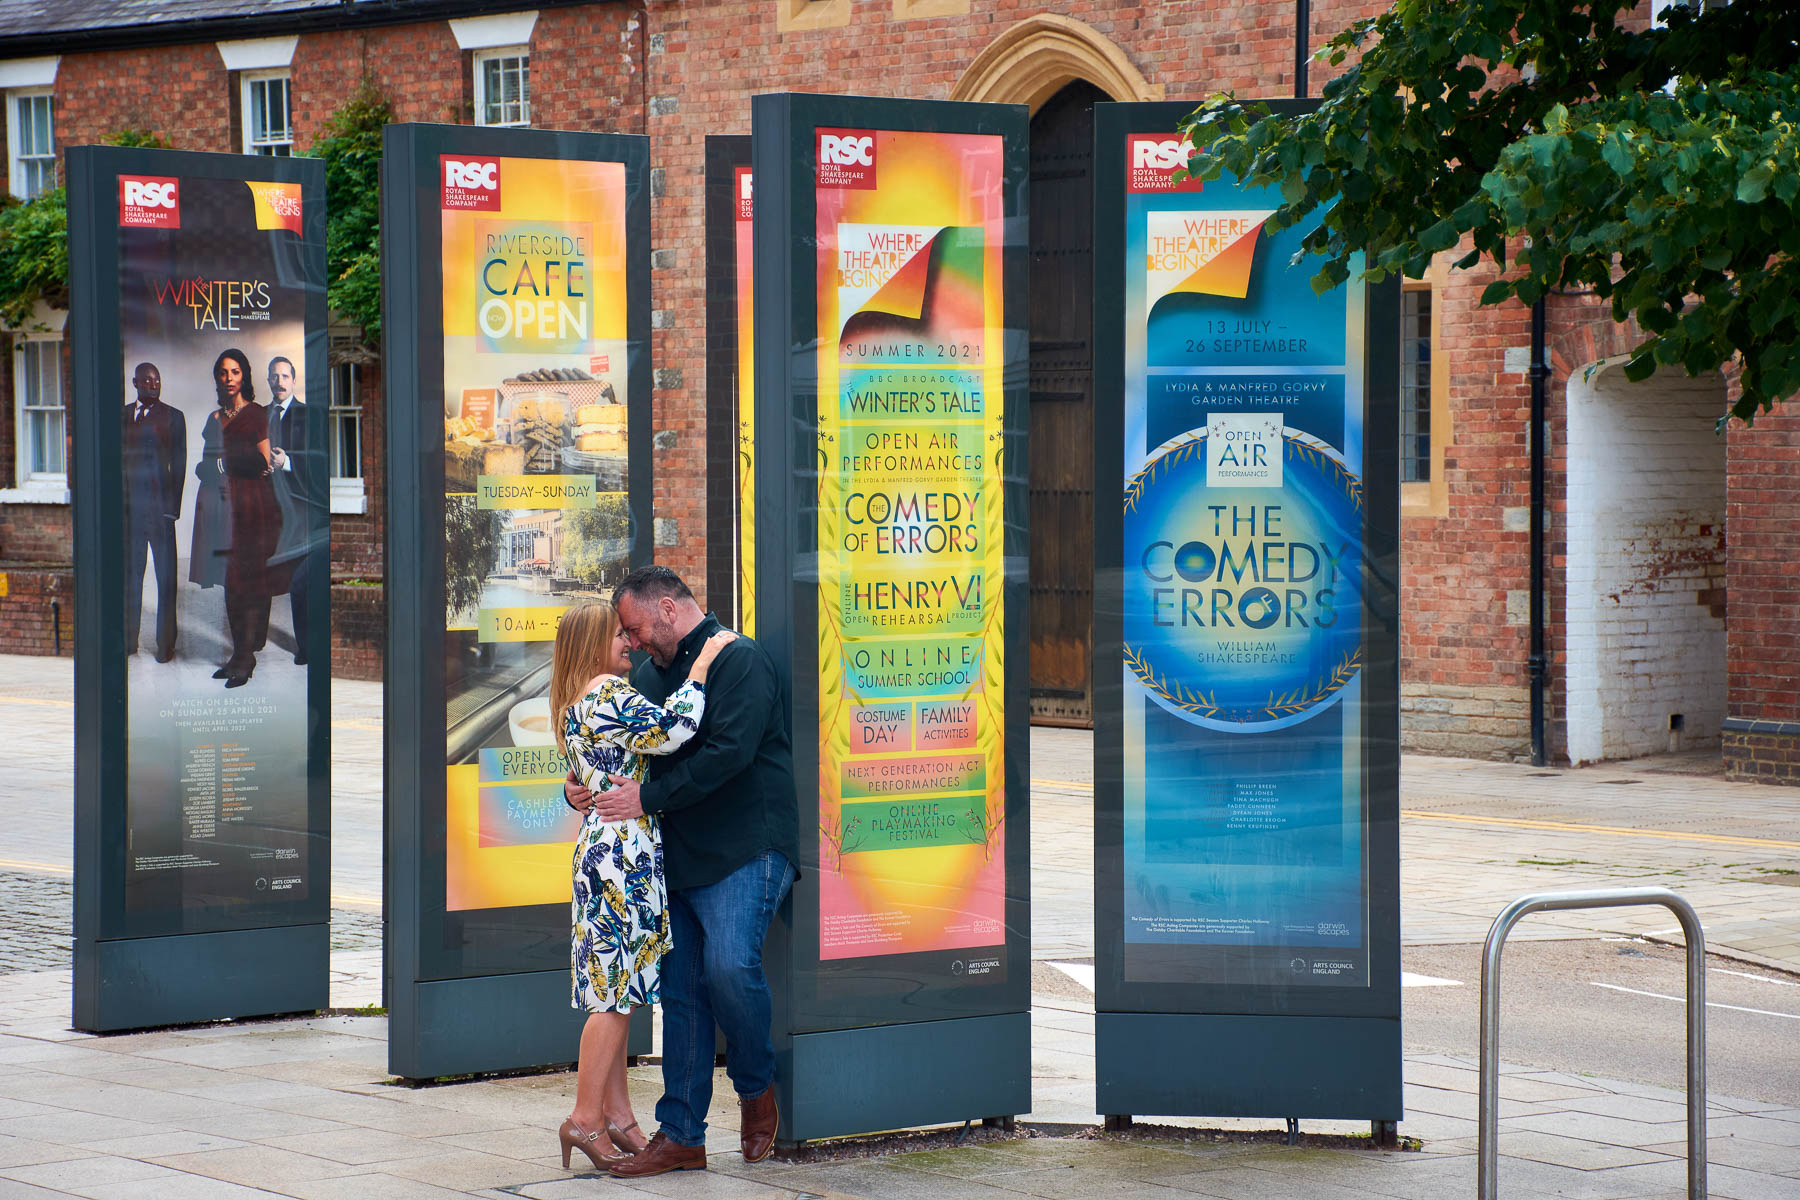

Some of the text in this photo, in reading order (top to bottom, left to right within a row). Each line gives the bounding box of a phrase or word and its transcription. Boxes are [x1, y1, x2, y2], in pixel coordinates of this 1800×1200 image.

[821, 135, 873, 166] RSC
[445, 160, 496, 190] RSC
[821, 170, 864, 179] SHAKESPEARE
[124, 181, 176, 209] RSC
[255, 189, 285, 198] WHERE
[264, 197, 298, 207] THEATRE
[274, 206, 300, 217] BEGINS
[1184, 218, 1249, 236] WHERE
[487, 234, 585, 256] RIVERSIDE
[868, 233, 922, 252] WHERE
[1153, 236, 1228, 254] THEATRE
[844, 251, 906, 269] THEATRE
[1147, 254, 1209, 271] BEGINS
[483, 258, 584, 297] CAFE
[837, 269, 890, 288] BEGINS
[154, 280, 271, 308] WINTER'S
[189, 304, 240, 330] TALE
[479, 298, 588, 340] OPEN
[1207, 320, 1226, 334] 13
[1233, 320, 1272, 334] JULY
[846, 344, 980, 357] SUMMER 2021
[1186, 338, 1308, 353] 26 SEPTEMBER
[1165, 383, 1326, 392] LYDIA & MANFRED GORVY
[848, 392, 980, 413] WINTER'S TALE
[1192, 395, 1300, 405] GARDEN THEATRE
[866, 433, 958, 450] OPEN AIR
[1225, 431, 1261, 442] OPEN
[843, 455, 982, 471] PERFORMANCES
[1218, 443, 1268, 467] AIR
[1218, 470, 1268, 478] PERFORMANCES
[845, 492, 980, 524] COMEDY
[1208, 505, 1282, 537] THE
[844, 524, 978, 554] OF ERRORS
[1141, 538, 1348, 586] COMEDY
[854, 580, 947, 610] HENRY
[1153, 586, 1338, 630] ERRORS
[845, 615, 869, 624] OPEN
[872, 614, 951, 626] REHEARSAL
[1217, 641, 1277, 652] WILLIAM
[855, 646, 970, 668] ONLINE
[1198, 653, 1297, 664] SHAKESPEARE
[858, 671, 970, 688] SUMMER SCHOOL
[172, 699, 202, 707] WATCH
[178, 708, 213, 717] SUNDAY
[231, 707, 254, 715] APRIL
[258, 705, 277, 713] 2021
[856, 710, 906, 724] COSTUME
[921, 706, 971, 724] FAMILY
[863, 725, 897, 743] DAY
[924, 728, 968, 740] ACTIVITIES
[503, 750, 567, 763] OPEN FO
[503, 762, 568, 775] EVERYON
[848, 761, 979, 778] NEXT GENERATION ACT
[868, 776, 960, 792] PERFORMANCES
[508, 807, 570, 820] PAYMENTS
[889, 804, 939, 818] ONLINE
[522, 818, 554, 828] ONLY
[872, 815, 956, 832] PLAYMAKING
[889, 828, 939, 841] FESTIVAL
